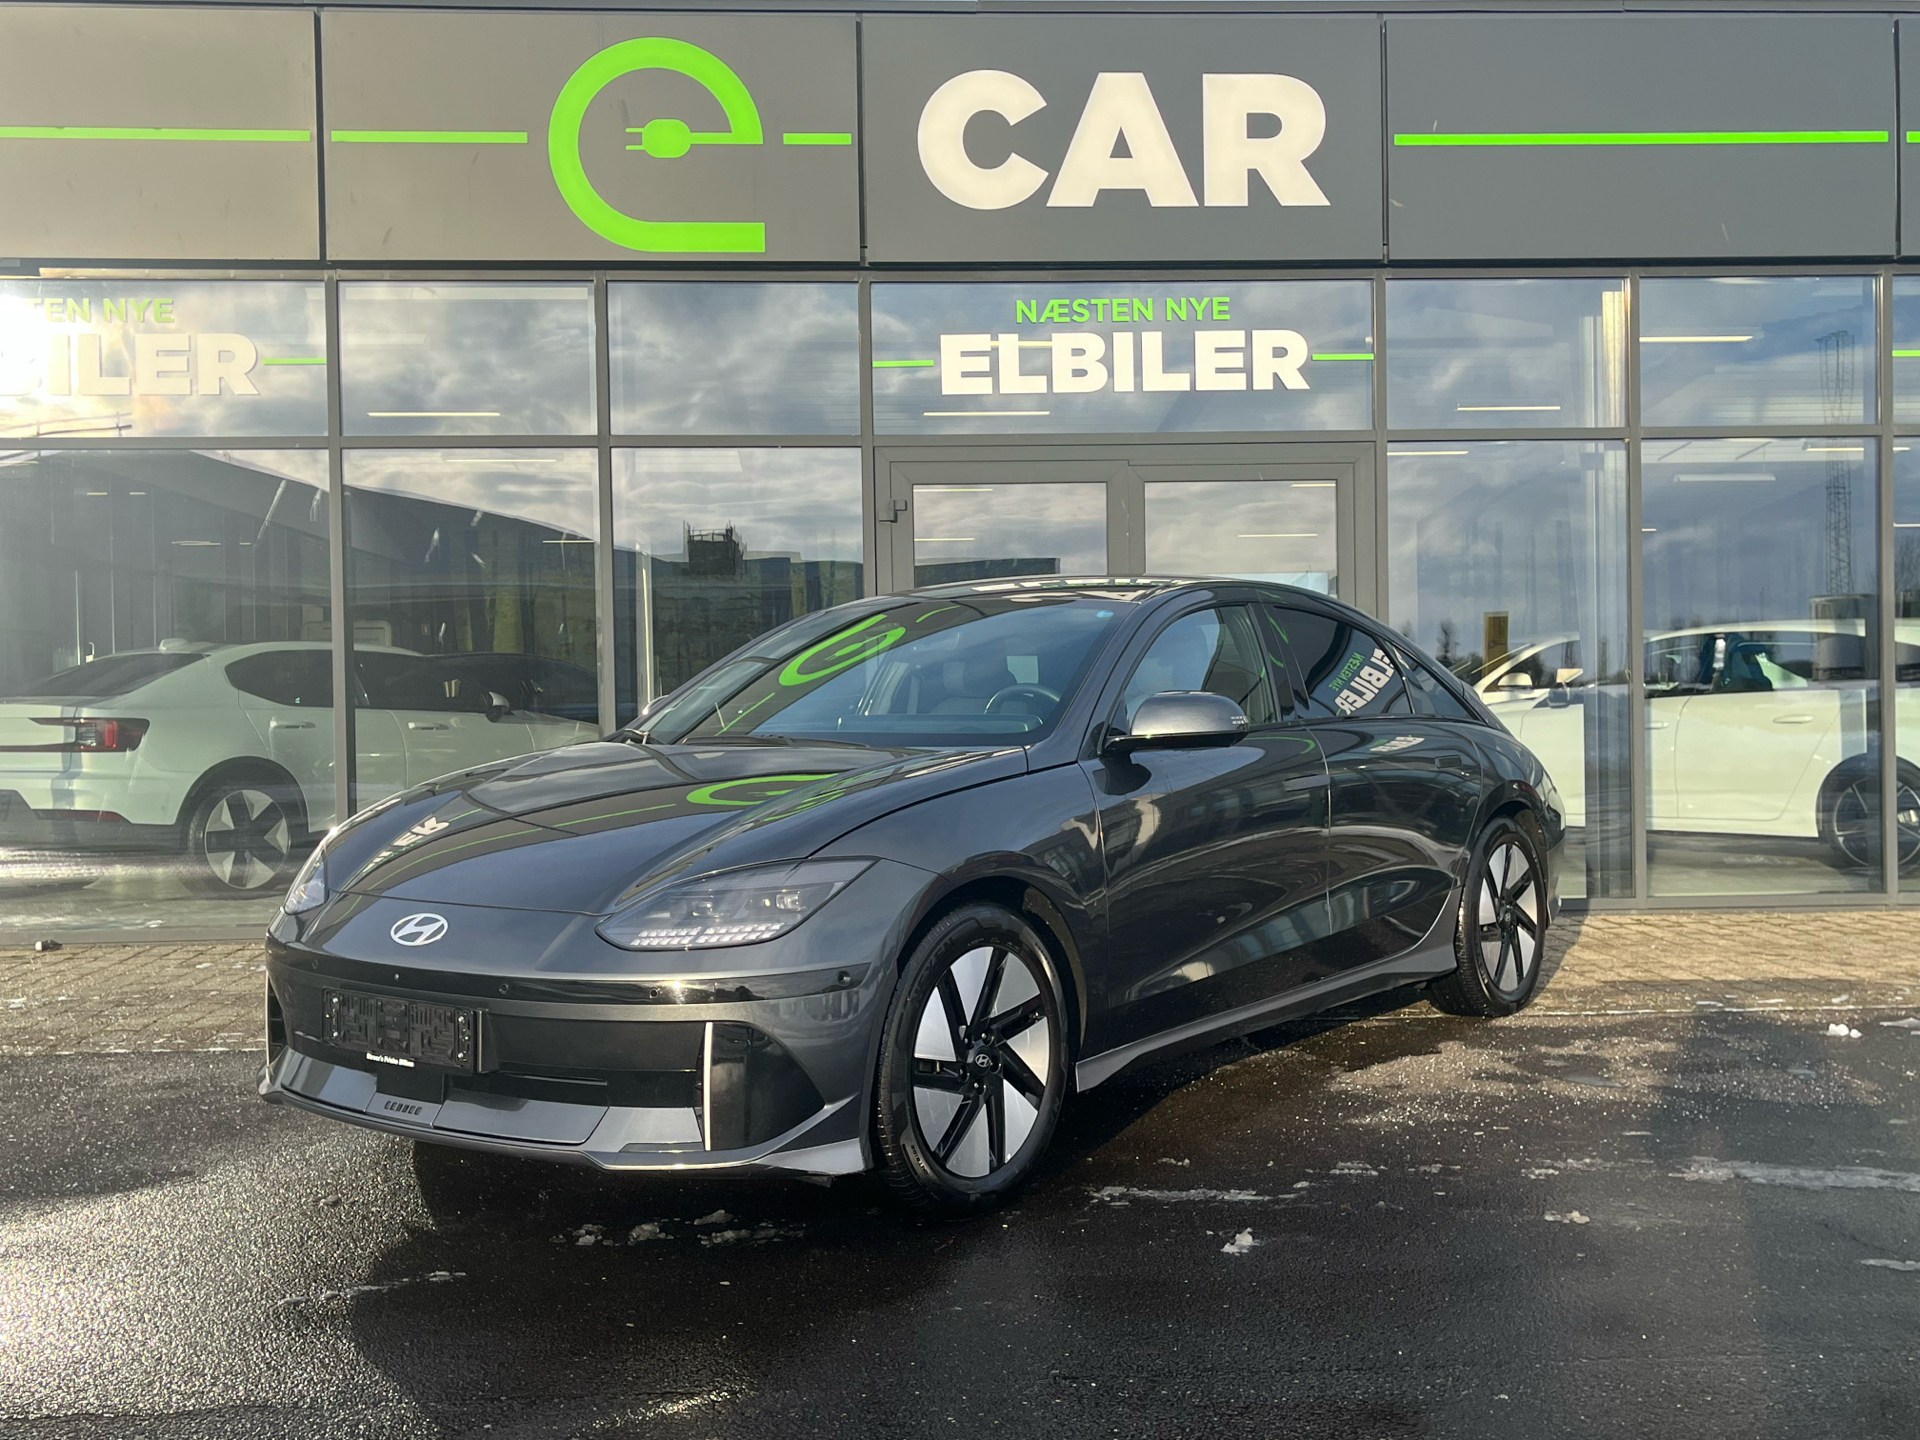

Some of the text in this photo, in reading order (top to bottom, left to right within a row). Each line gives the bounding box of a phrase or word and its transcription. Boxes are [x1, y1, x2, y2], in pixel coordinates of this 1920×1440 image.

[917, 69, 1331, 209] CAR
[103, 297, 174, 323] NYE
[1015, 296, 1231, 324] NÆSTEN NYE
[0, 333, 260, 396] ILER
[939, 329, 1311, 396] ELBILER
